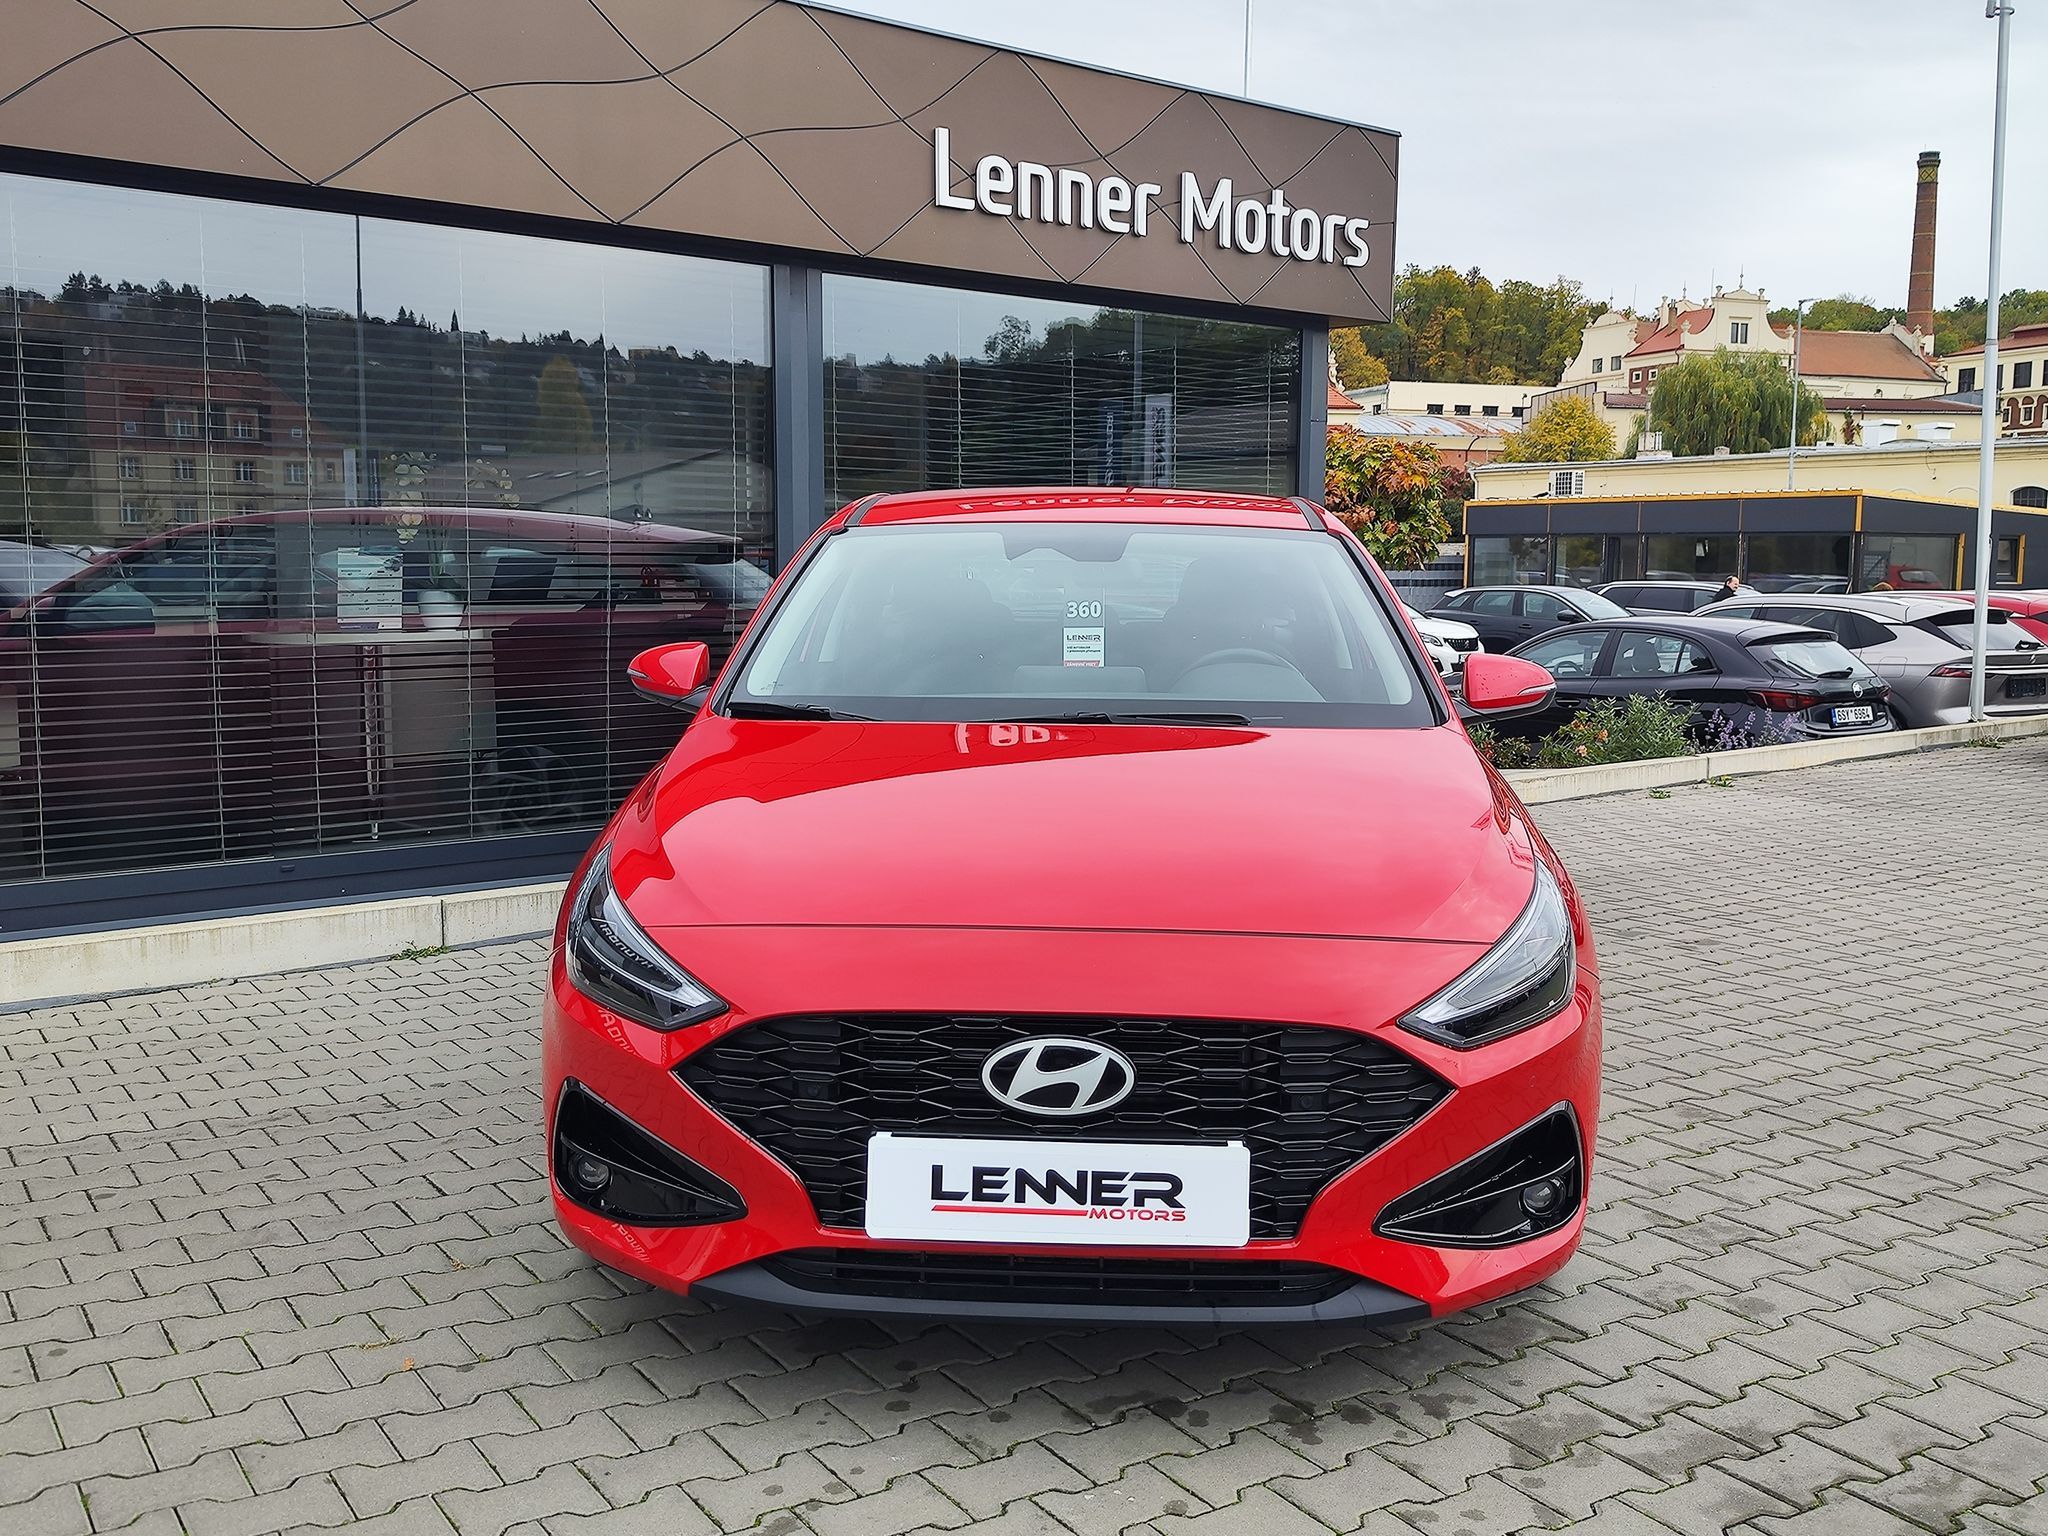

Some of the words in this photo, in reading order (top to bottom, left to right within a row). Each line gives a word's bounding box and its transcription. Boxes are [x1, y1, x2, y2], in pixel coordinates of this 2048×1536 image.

[934, 127, 1161, 237] Lenner
[1180, 171, 1370, 268] Motors
[1066, 600, 1102, 618] 360
[1066, 634, 1101, 642] LENNER
[931, 1164, 1186, 1209] LENNER
[1088, 1207, 1186, 1222] MOTORS
